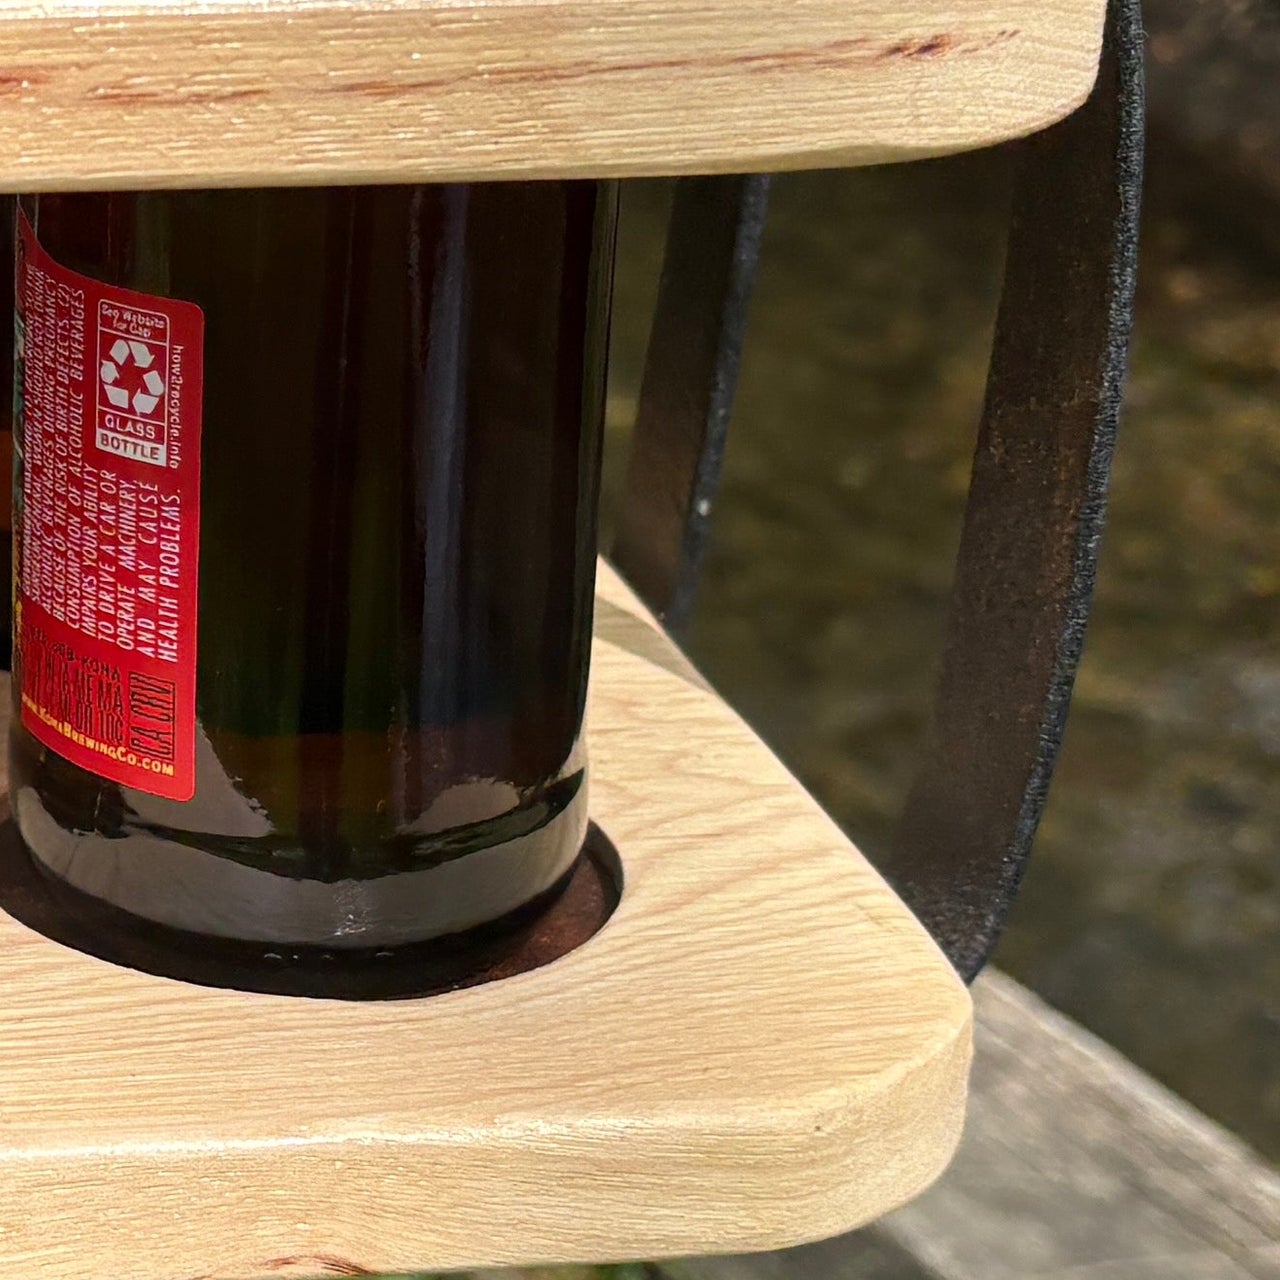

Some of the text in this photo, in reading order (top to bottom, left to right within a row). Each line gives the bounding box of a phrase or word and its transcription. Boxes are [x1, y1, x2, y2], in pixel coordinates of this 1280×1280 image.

[44, 275, 57, 367] PREGNANCY
[43, 368, 55, 435] DURING
[56, 387, 69, 432] BIRTH
[105, 415, 156, 439] GLASS
[55, 461, 67, 495] RISK
[56, 435, 68, 456] OF
[66, 289, 85, 629] CONSUMPTION OF ALCOHOLIC BEVERAGES
[100, 432, 159, 460] BOTTLE
[42, 440, 54, 526] BEVERAGES
[55, 498, 67, 527] THE
[54, 532, 66, 551] OF
[80, 463, 99, 637] IMPAIRS YOUR ABILITY
[98, 469, 117, 643] TO DRIVE A CAR OR
[116, 479, 138, 651] OPERATE MACHINERY,
[136, 481, 158, 657] AND MAY CAUSE
[157, 488, 181, 662] HEALTH PROBLEMS.
[52, 555, 65, 621] BECAUSE
